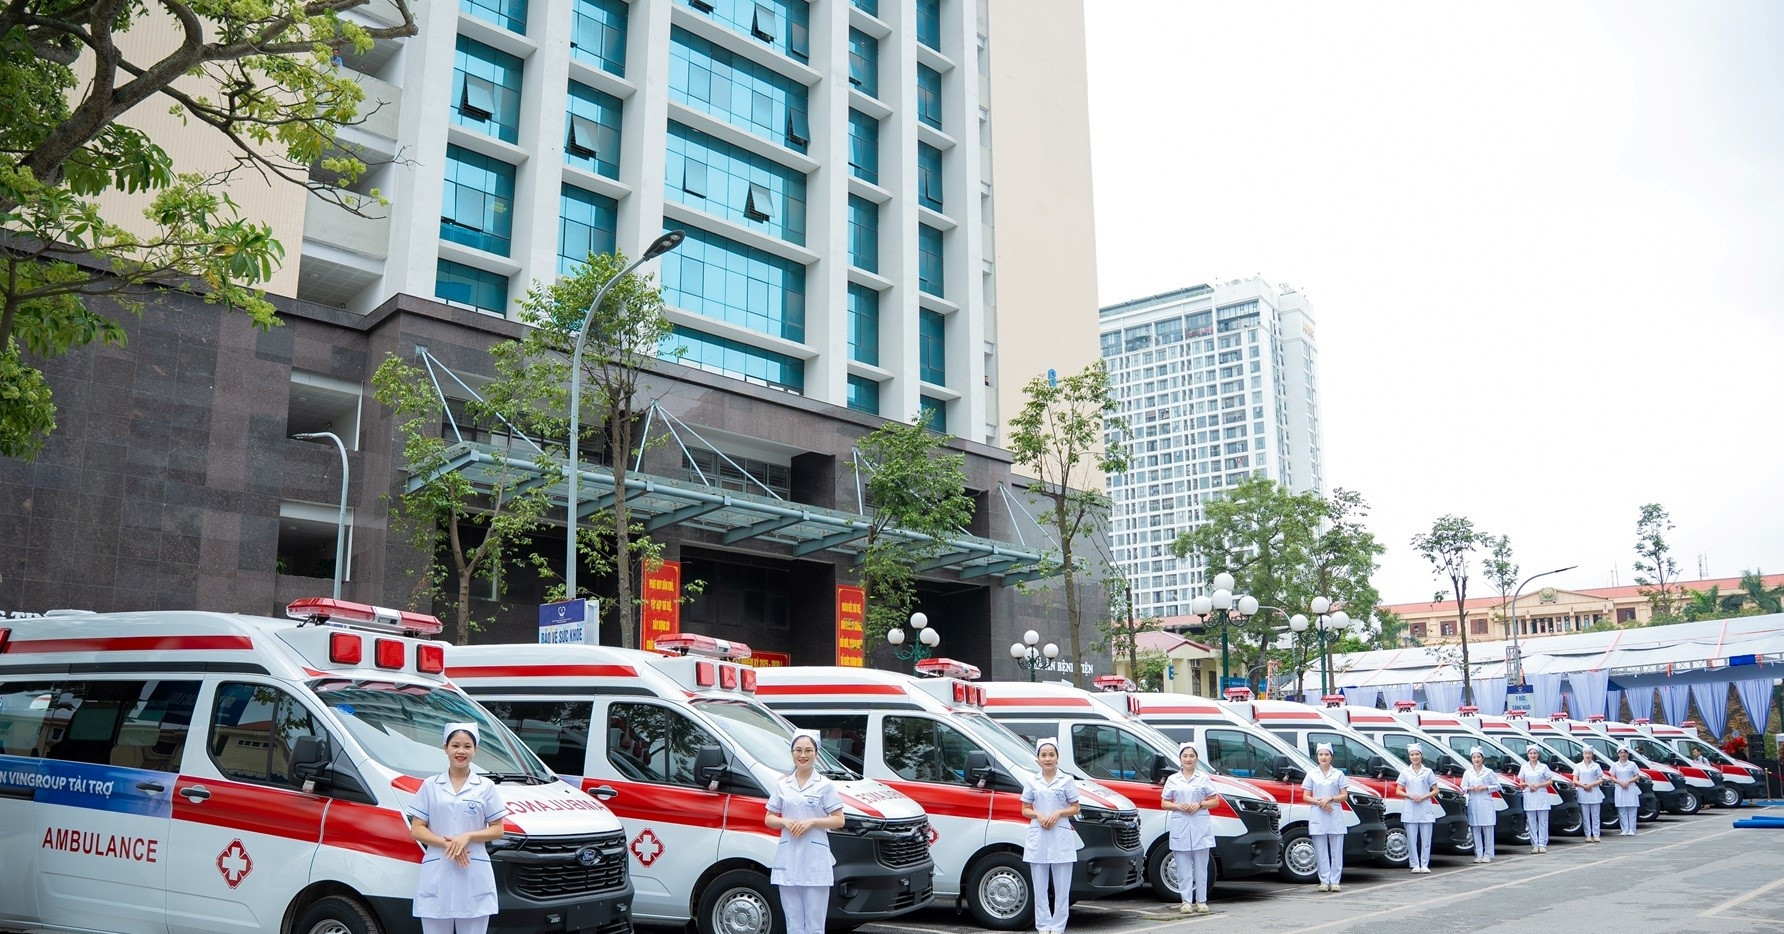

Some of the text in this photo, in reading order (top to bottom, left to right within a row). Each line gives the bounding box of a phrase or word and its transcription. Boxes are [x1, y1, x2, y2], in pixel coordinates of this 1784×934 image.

[559, 628, 568, 643] SỨC
[0, 770, 114, 799] N VINGROUP TÀI TRỢ
[42, 827, 158, 863] AMBULANCE
[582, 851, 596, 860] Ford
